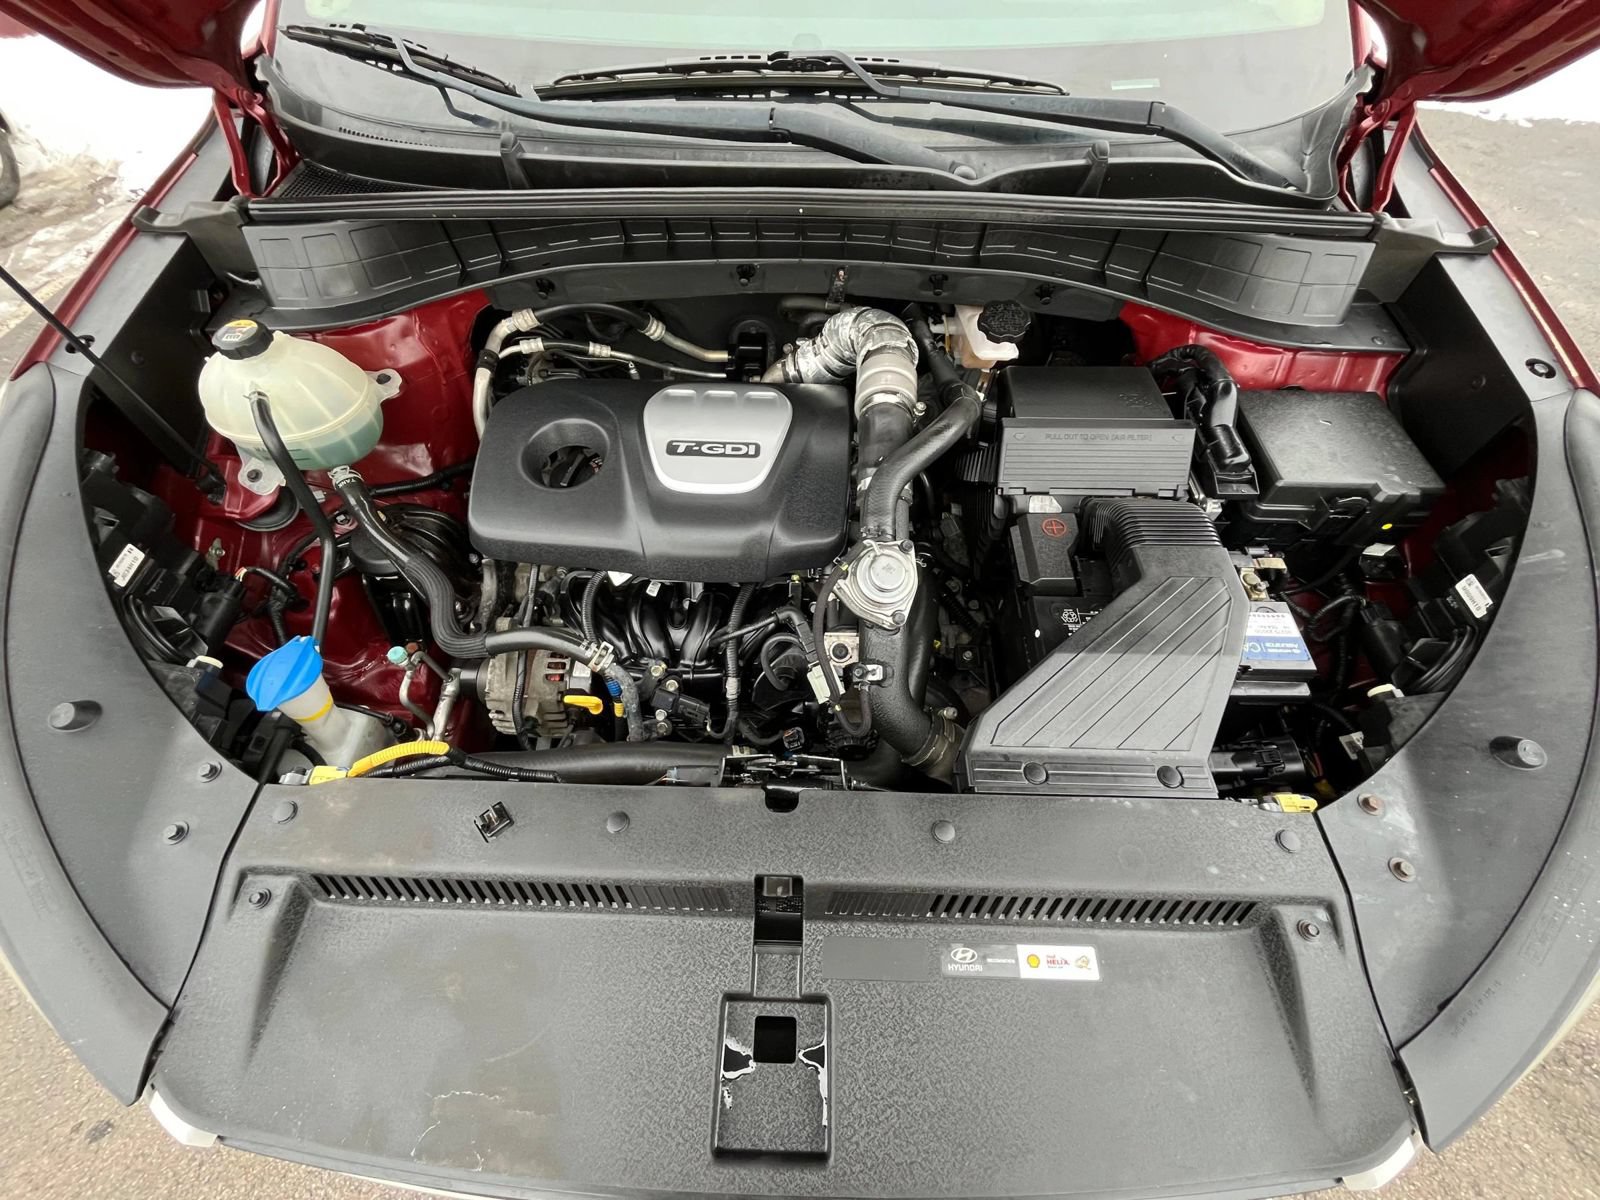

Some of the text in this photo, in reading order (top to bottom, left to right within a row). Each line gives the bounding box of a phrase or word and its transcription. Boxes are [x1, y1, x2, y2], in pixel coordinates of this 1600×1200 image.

[1045, 432, 1063, 441] PULL
[1064, 432, 1078, 441] OUT
[1079, 433, 1089, 441] TO
[1090, 433, 1108, 441] OPEN
[671, 441, 756, 456] T-GDI
[338, 478, 357, 489] TANK
[947, 963, 983, 972] HYUNDAI
